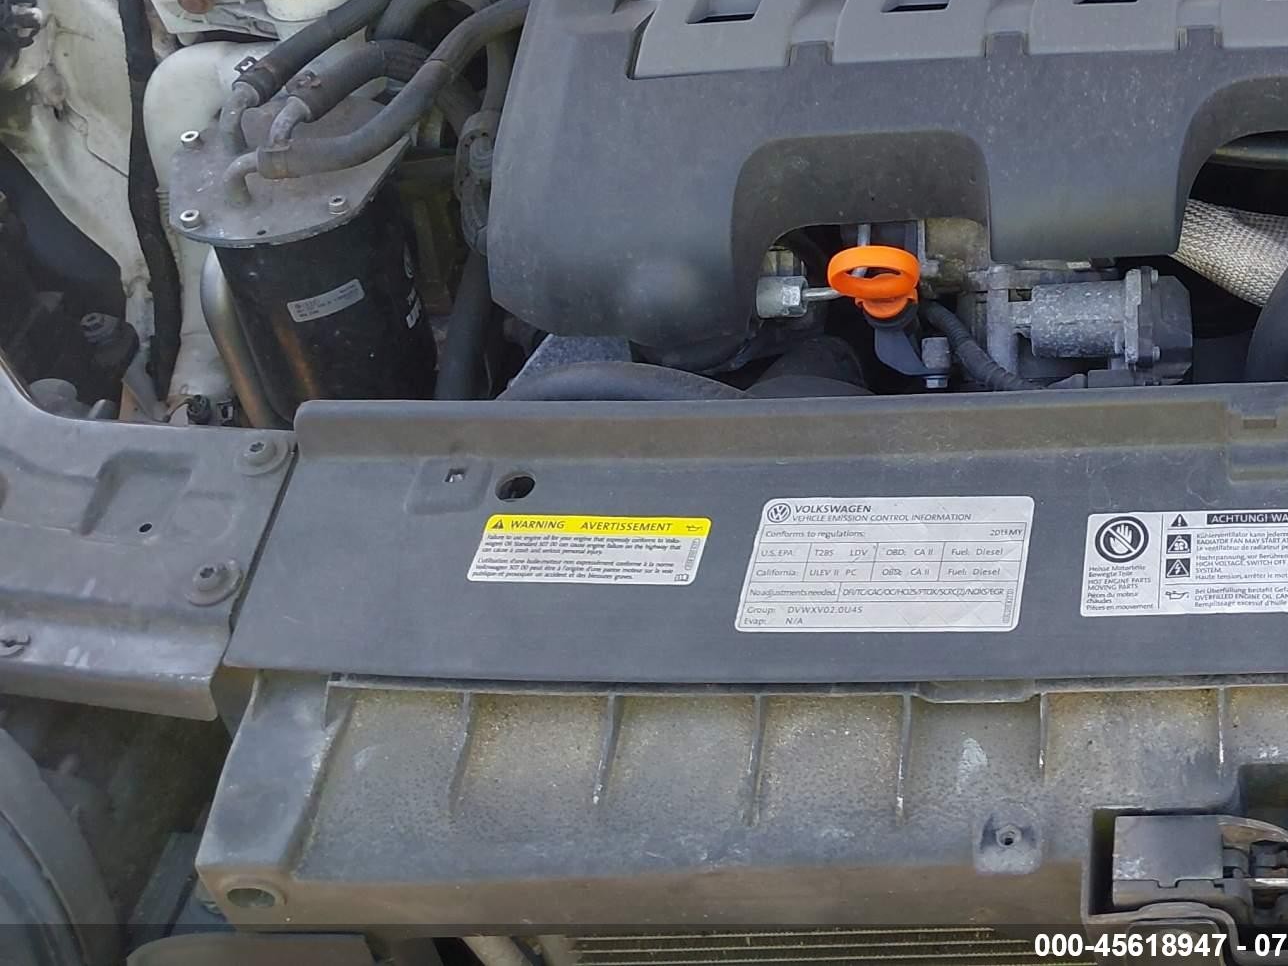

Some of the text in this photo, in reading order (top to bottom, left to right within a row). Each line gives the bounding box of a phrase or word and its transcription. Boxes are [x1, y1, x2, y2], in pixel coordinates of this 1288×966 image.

[795, 505, 872, 514] VOLKSWAGEN
[870, 514, 909, 522] CONTROL
[911, 513, 972, 521] INFORMATION
[1211, 513, 1268, 523] ACHTUNG!
[510, 520, 673, 531] WARNING AVERTISSEMENT
[785, 617, 803, 625] N/A
